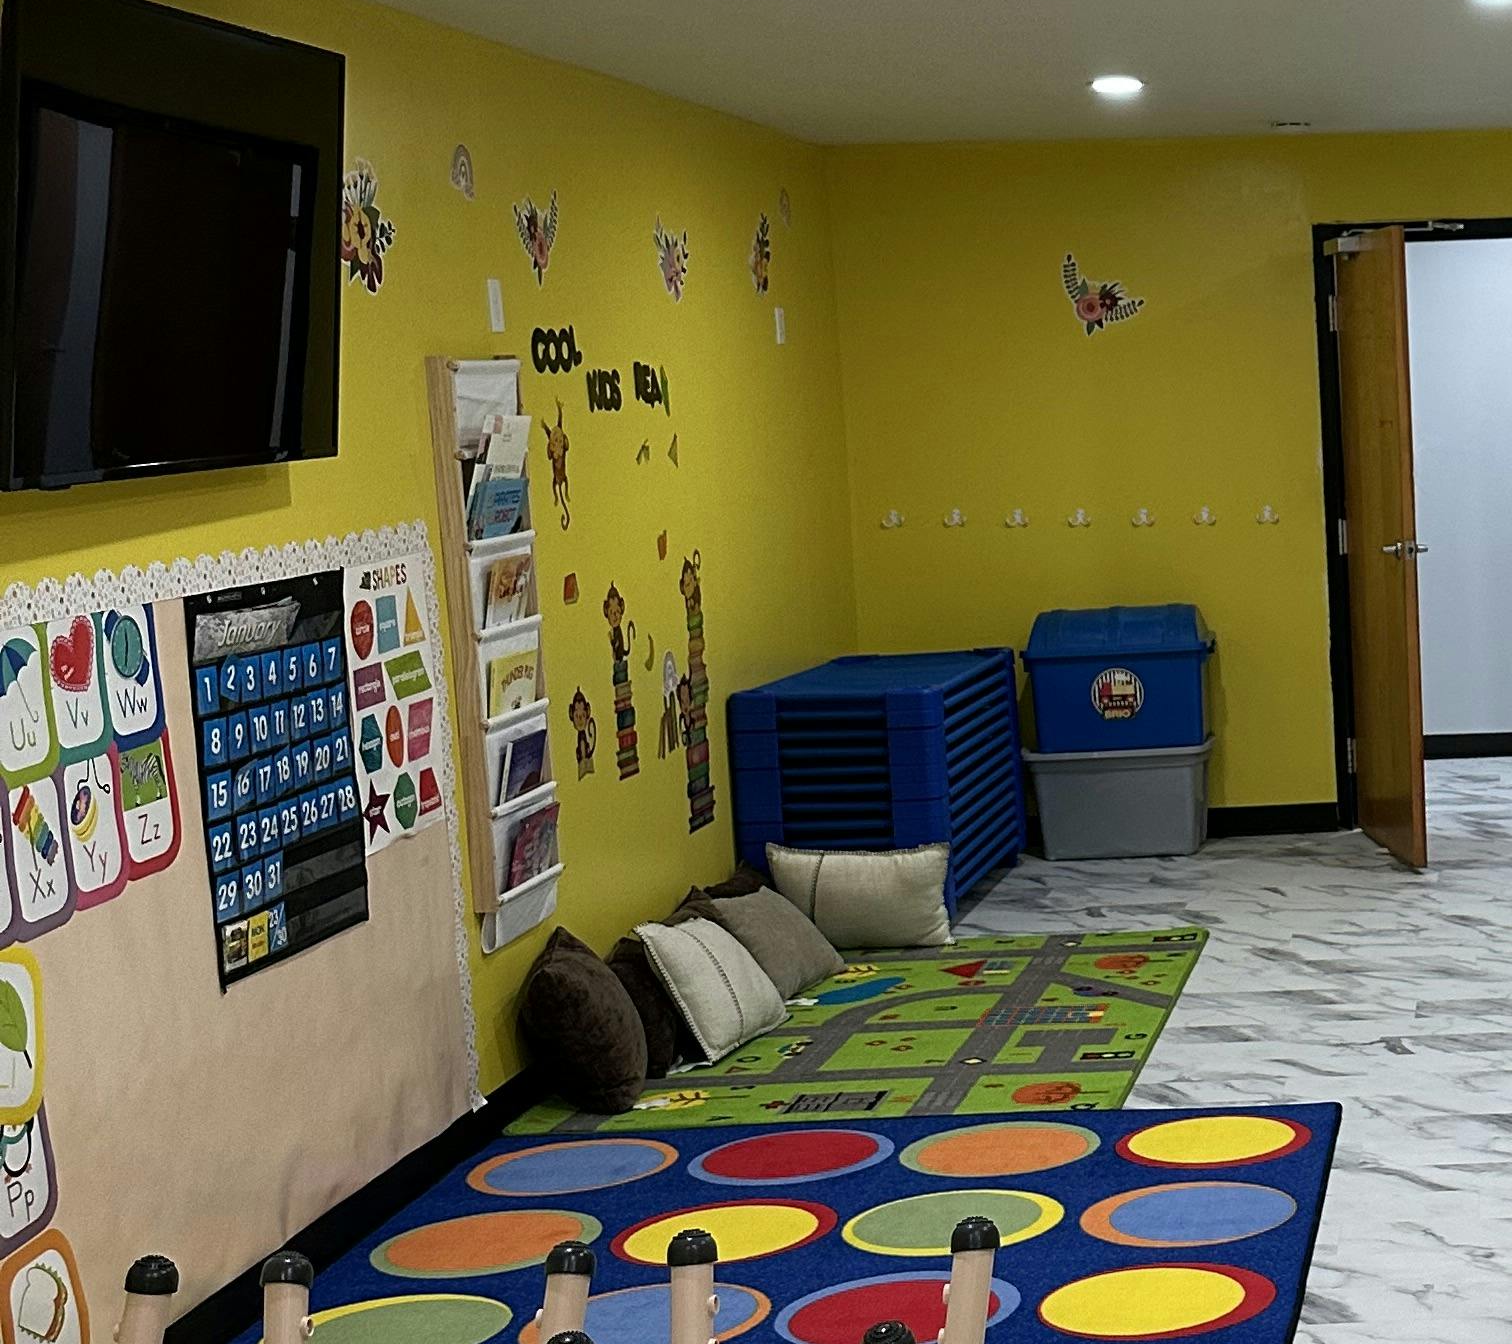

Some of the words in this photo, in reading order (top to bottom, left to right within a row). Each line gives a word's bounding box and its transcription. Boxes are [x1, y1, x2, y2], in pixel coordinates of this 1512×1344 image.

[531, 324, 583, 374] COOL
[586, 368, 622, 413] KIDS
[373, 563, 407, 591] SHAPES
[218, 619, 281, 647] January
[204, 677, 212, 703] 1
[227, 665, 236, 691] 2
[246, 666, 255, 691] 3
[268, 660, 276, 685] 4
[289, 657, 297, 681] 5
[309, 654, 317, 678] 6
[328, 647, 337, 671] 7
[66, 698, 89, 729] Vv
[116, 687, 148, 718] Ww
[211, 728, 221, 754] 8
[235, 724, 244, 749] 9
[254, 715, 268, 741] 10
[275, 710, 285, 735] 11
[293, 704, 306, 728] 12
[311, 698, 324, 722] 13
[331, 692, 343, 717] 14
[10, 718, 37, 751] Uu
[211, 780, 227, 808] 15
[237, 771, 249, 797] 16
[259, 765, 271, 792] 17
[277, 756, 290, 783] 18
[295, 751, 309, 777] 19
[315, 745, 330, 771] 20
[336, 736, 348, 762] 21
[138, 814, 161, 845] Zz
[212, 832, 232, 862] 22
[240, 820, 257, 850] 23
[262, 814, 279, 843] 24
[282, 807, 298, 834] 25
[302, 799, 318, 826] 26
[320, 792, 336, 819] 27
[338, 785, 355, 811] 28
[83, 840, 108, 883] Yy
[29, 869, 56, 903] Xx
[218, 881, 238, 911] 29
[245, 871, 262, 900] 30
[267, 862, 281, 889] 31
[7, 1180, 35, 1222] Pp
